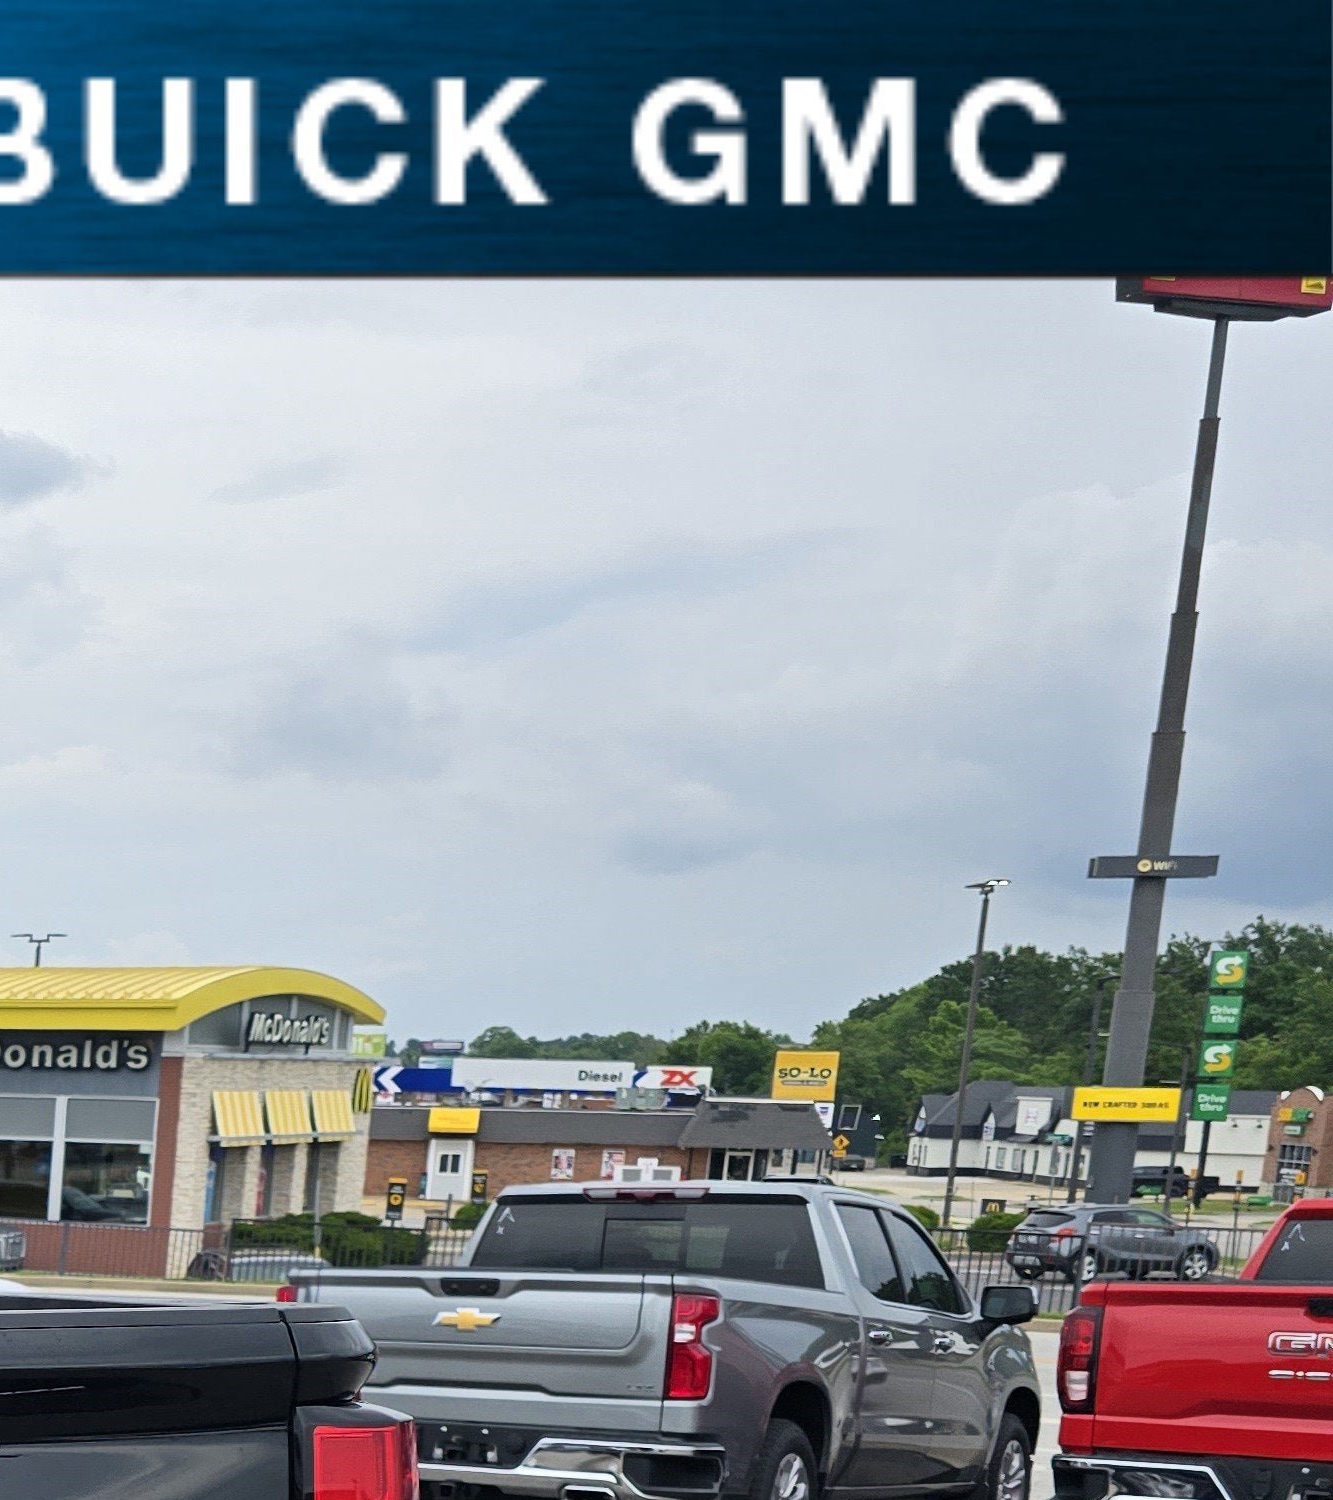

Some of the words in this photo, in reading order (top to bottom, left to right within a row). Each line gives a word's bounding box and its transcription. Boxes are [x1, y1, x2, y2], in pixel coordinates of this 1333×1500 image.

[1210, 1005, 1238, 1015] Drive
[1212, 1015, 1235, 1024] thru
[248, 1013, 330, 1045] McDonald's
[577, 1069, 624, 1083] Diesel
[660, 1069, 699, 1087] ZX
[778, 1066, 832, 1080] SO-LO
[1198, 1094, 1227, 1104] Drive
[1199, 1103, 1224, 1112] thru
